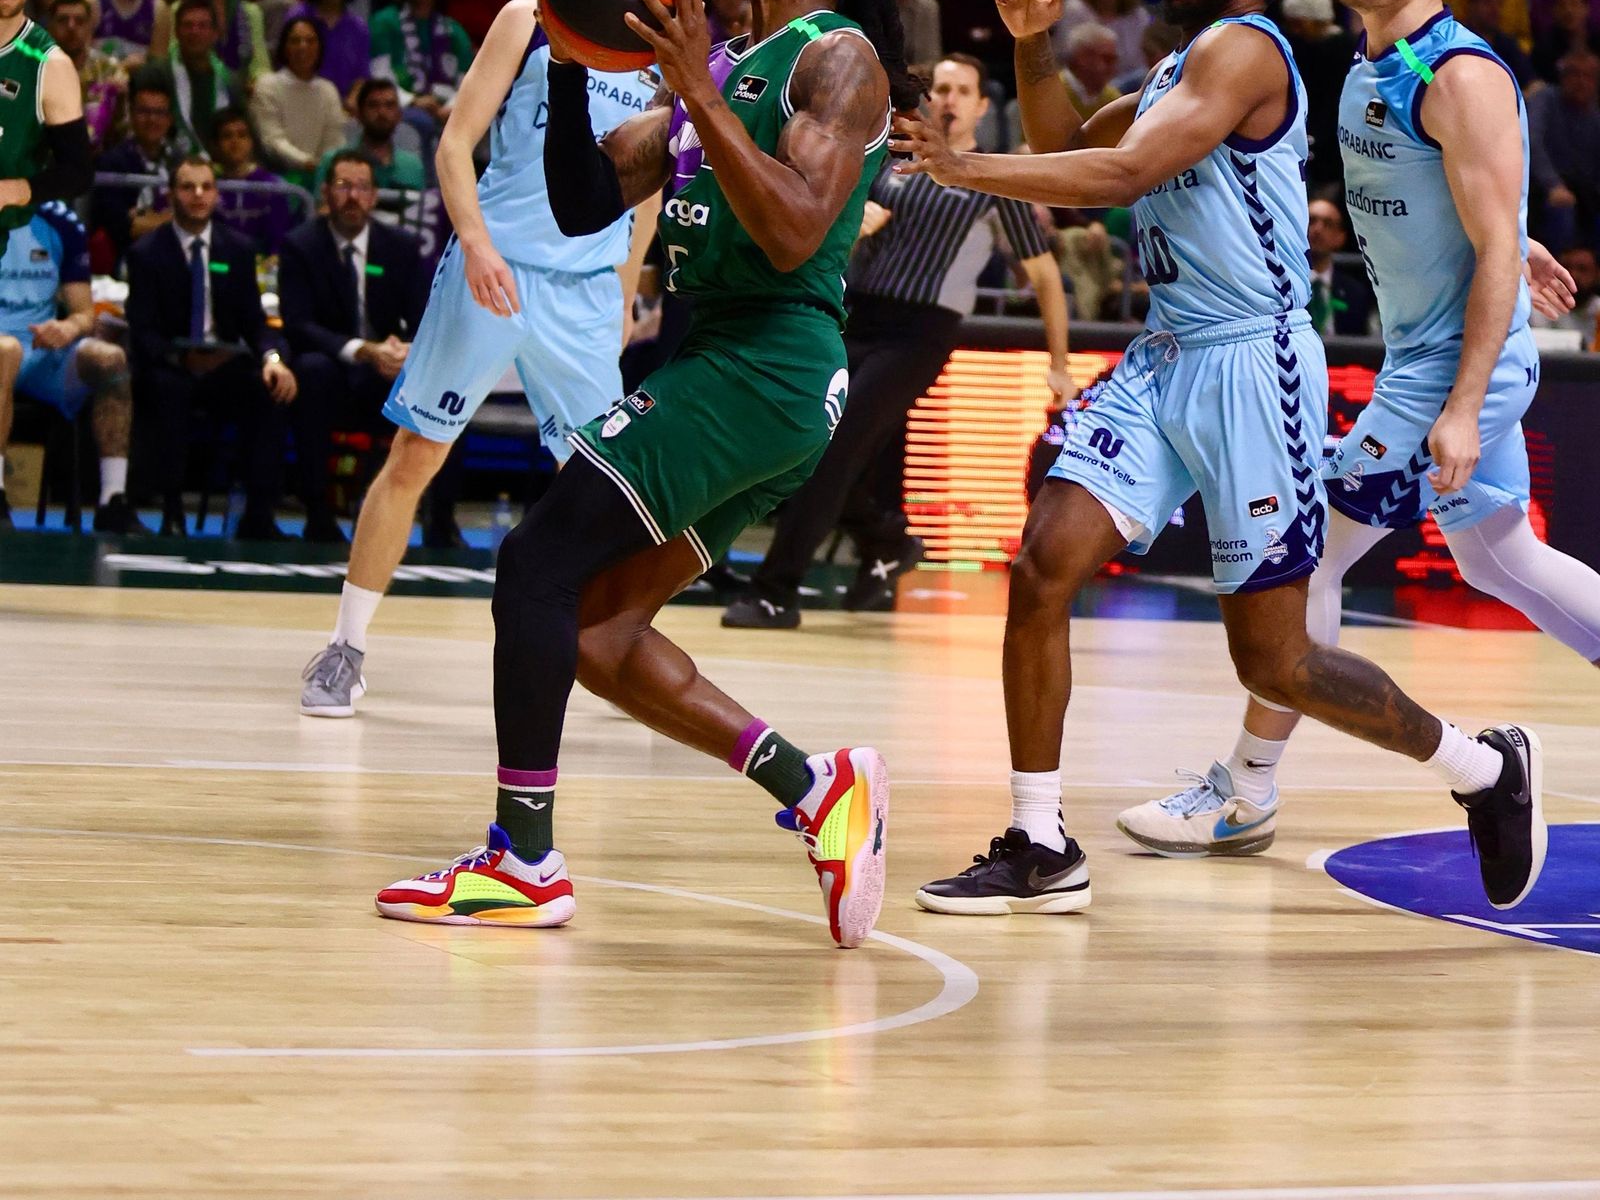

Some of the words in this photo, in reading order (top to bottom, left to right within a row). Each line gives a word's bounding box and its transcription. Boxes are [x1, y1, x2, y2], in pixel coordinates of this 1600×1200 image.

[587, 75, 643, 113] ORABA
[1338, 125, 1396, 160] ORABANC
[1347, 187, 1409, 217] ndorra
[631, 396, 645, 409] acb
[1361, 441, 1379, 457] acb
[1100, 461, 1110, 472] la
[1112, 467, 1136, 486] Vella
[1252, 504, 1273, 516] acb
[1210, 539, 1248, 550] ndorra
[1212, 552, 1253, 563] elecom
